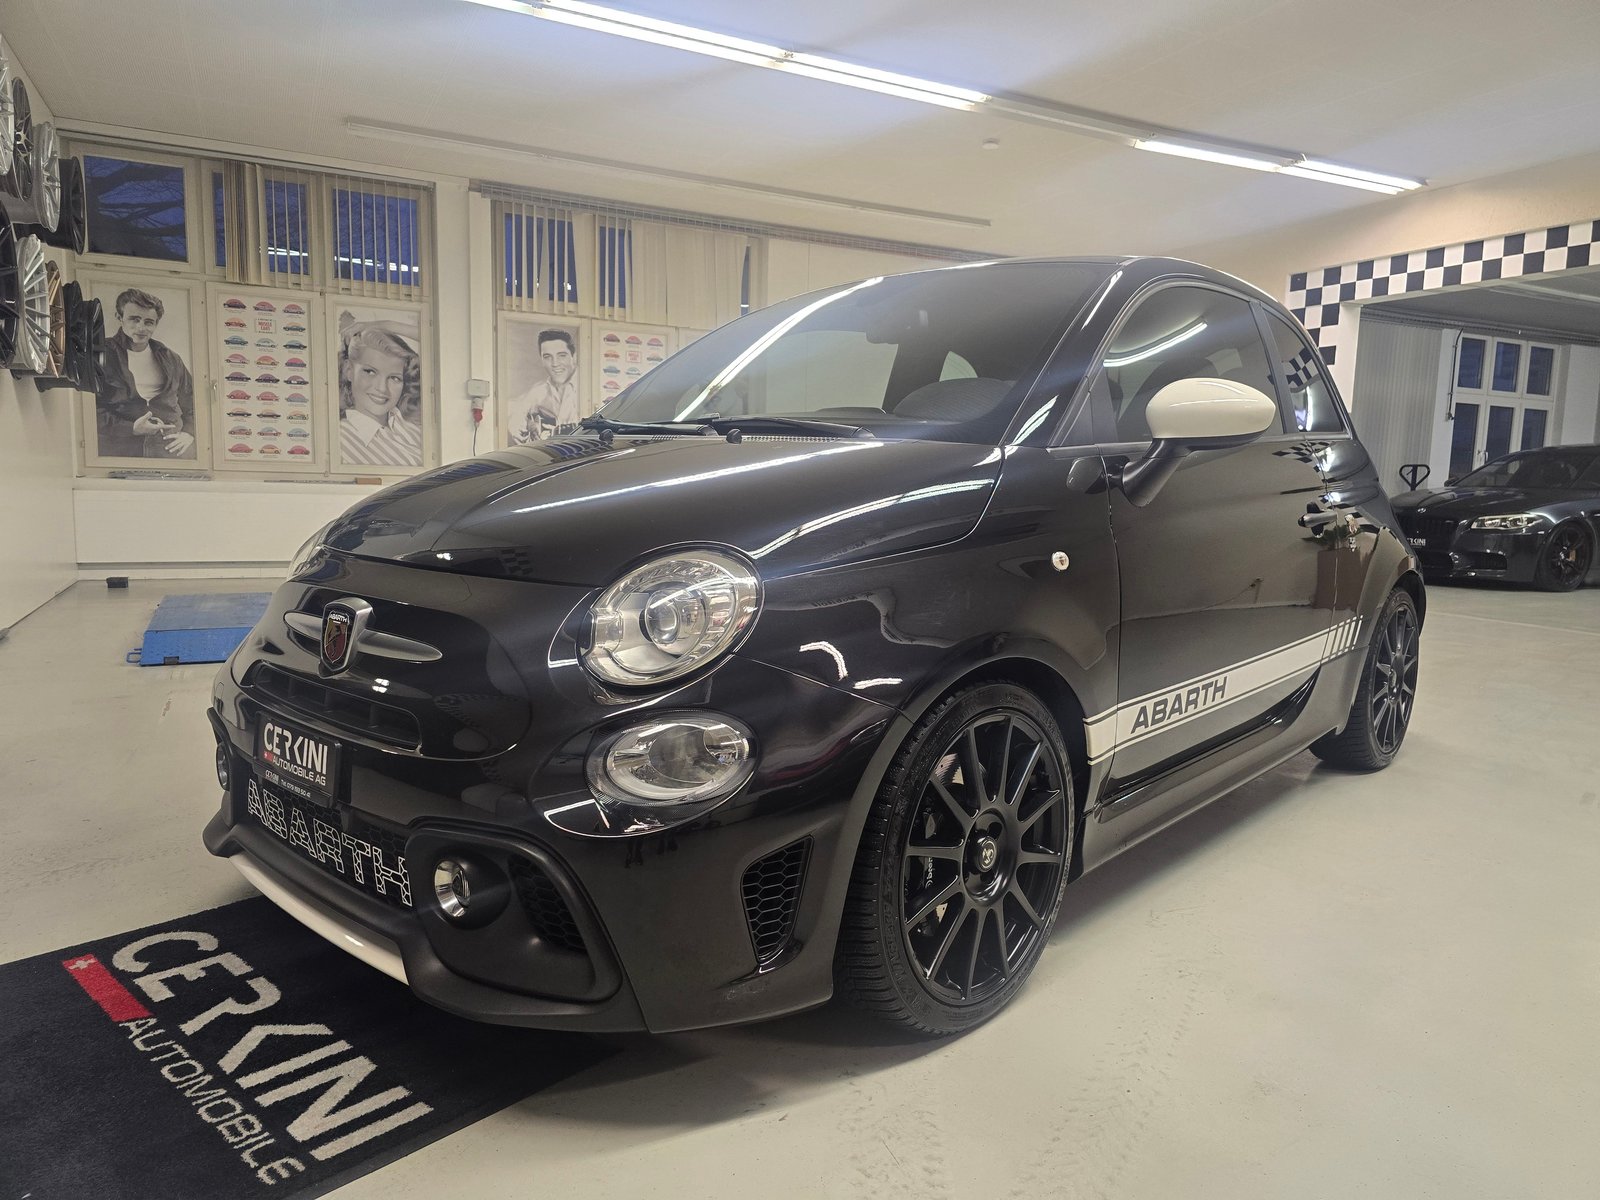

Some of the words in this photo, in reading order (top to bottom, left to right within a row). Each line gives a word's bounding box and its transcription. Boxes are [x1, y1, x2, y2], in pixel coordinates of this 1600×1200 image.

[329, 613, 347, 623] ABARTH
[1131, 677, 1228, 734] ABARTH
[264, 723, 328, 774] CERKINI
[273, 756, 314, 781] AUTOMOBILE
[315, 774, 326, 786] AG
[248, 778, 412, 907] ABARTH
[112, 931, 434, 1160] CERKINI
[119, 1018, 306, 1185] AUTOMOBILE
